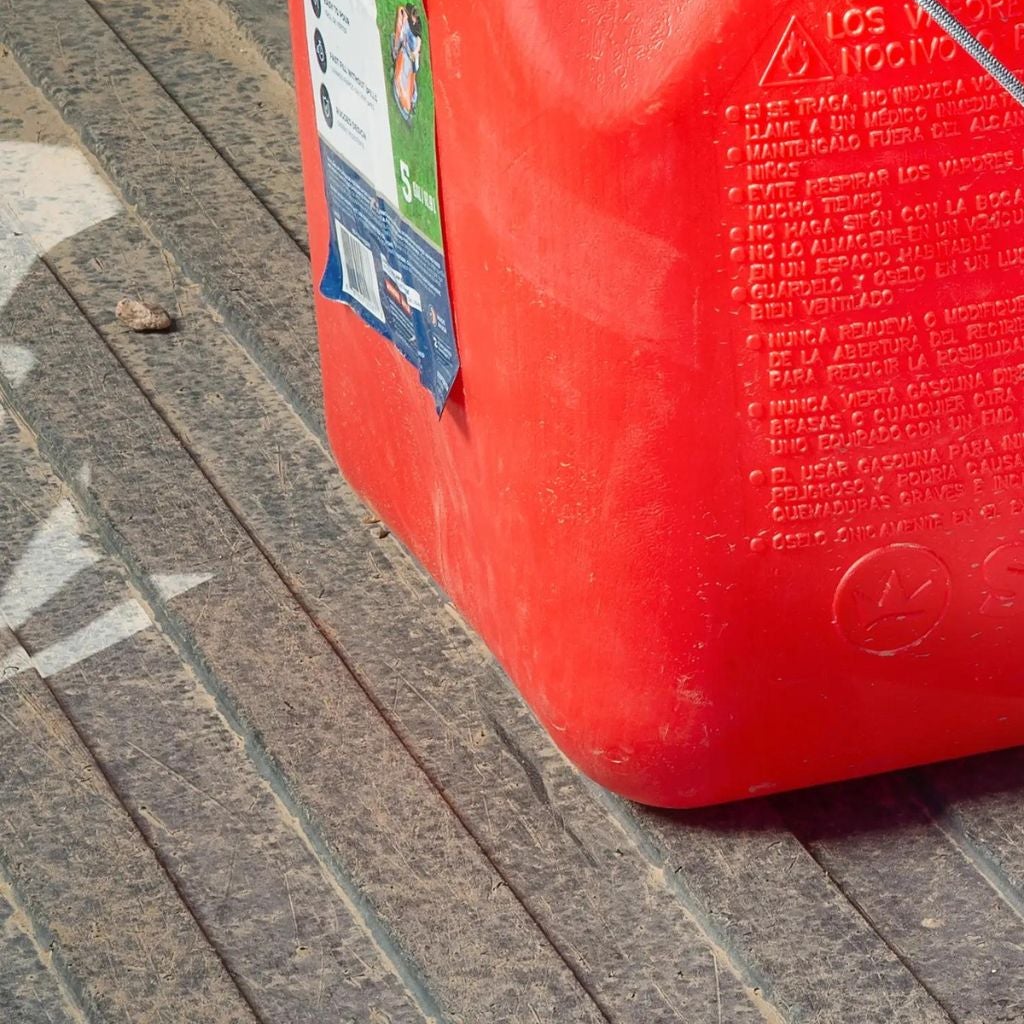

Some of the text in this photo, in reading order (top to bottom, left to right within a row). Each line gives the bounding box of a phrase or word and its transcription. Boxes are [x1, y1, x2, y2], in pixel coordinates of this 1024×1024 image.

[826, 6, 885, 39] LOS
[839, 34, 957, 72] NOCIVO
[743, 80, 967, 119] SI SE TRAGA, NO INDUZCA
[744, 114, 856, 141] LLAME A UN
[868, 120, 962, 146] FUERA DEL
[400, 159, 412, 203] 5
[746, 180, 798, 202] EVITE
[804, 170, 890, 193] RESPIRAR
[897, 164, 931, 182] LOS
[937, 152, 1014, 174] VAPORES
[747, 187, 1024, 240] NO HAGA CON LA BOCA
[749, 192, 883, 220] MUCHO TIEMPO
[748, 219, 958, 262] NO LO ALMACENE EN UN
[749, 235, 992, 280] EN UN ESPACIO HABITABLE
[852, 273, 865, 289] Y
[934, 259, 958, 278] EN
[962, 254, 990, 273] UN
[750, 289, 894, 321] BIEN VENTILADO
[766, 326, 830, 349] NUNCA
[837, 315, 918, 339] REMUEVA
[922, 311, 938, 328] O
[768, 350, 792, 369] DE
[800, 347, 822, 365] LA
[832, 335, 922, 359] ABERTURA
[928, 328, 959, 347] DEL
[768, 365, 814, 388] PARA
[825, 357, 900, 380] REDUCIR
[907, 353, 928, 370] LA
[768, 393, 832, 416] NUNCA
[840, 385, 900, 408] VIERTA
[905, 373, 985, 397] GASOLINA
[768, 412, 841, 436] BRASAS
[872, 396, 967, 422] CUALQUIER
[972, 386, 1017, 408] OTRA
[817, 424, 901, 449] EQUIPADO
[948, 413, 973, 431] UN
[770, 466, 792, 484] EL
[799, 460, 849, 481] USAR
[856, 449, 940, 472] GASOLINA
[948, 438, 995, 459] PARA
[770, 477, 865, 503] PELIGROSO
[770, 491, 892, 521] QUEMADURAS
[898, 482, 964, 504] GRAVES
[972, 478, 984, 494] E
[950, 508, 975, 525] EN
[979, 502, 1001, 520] EL
